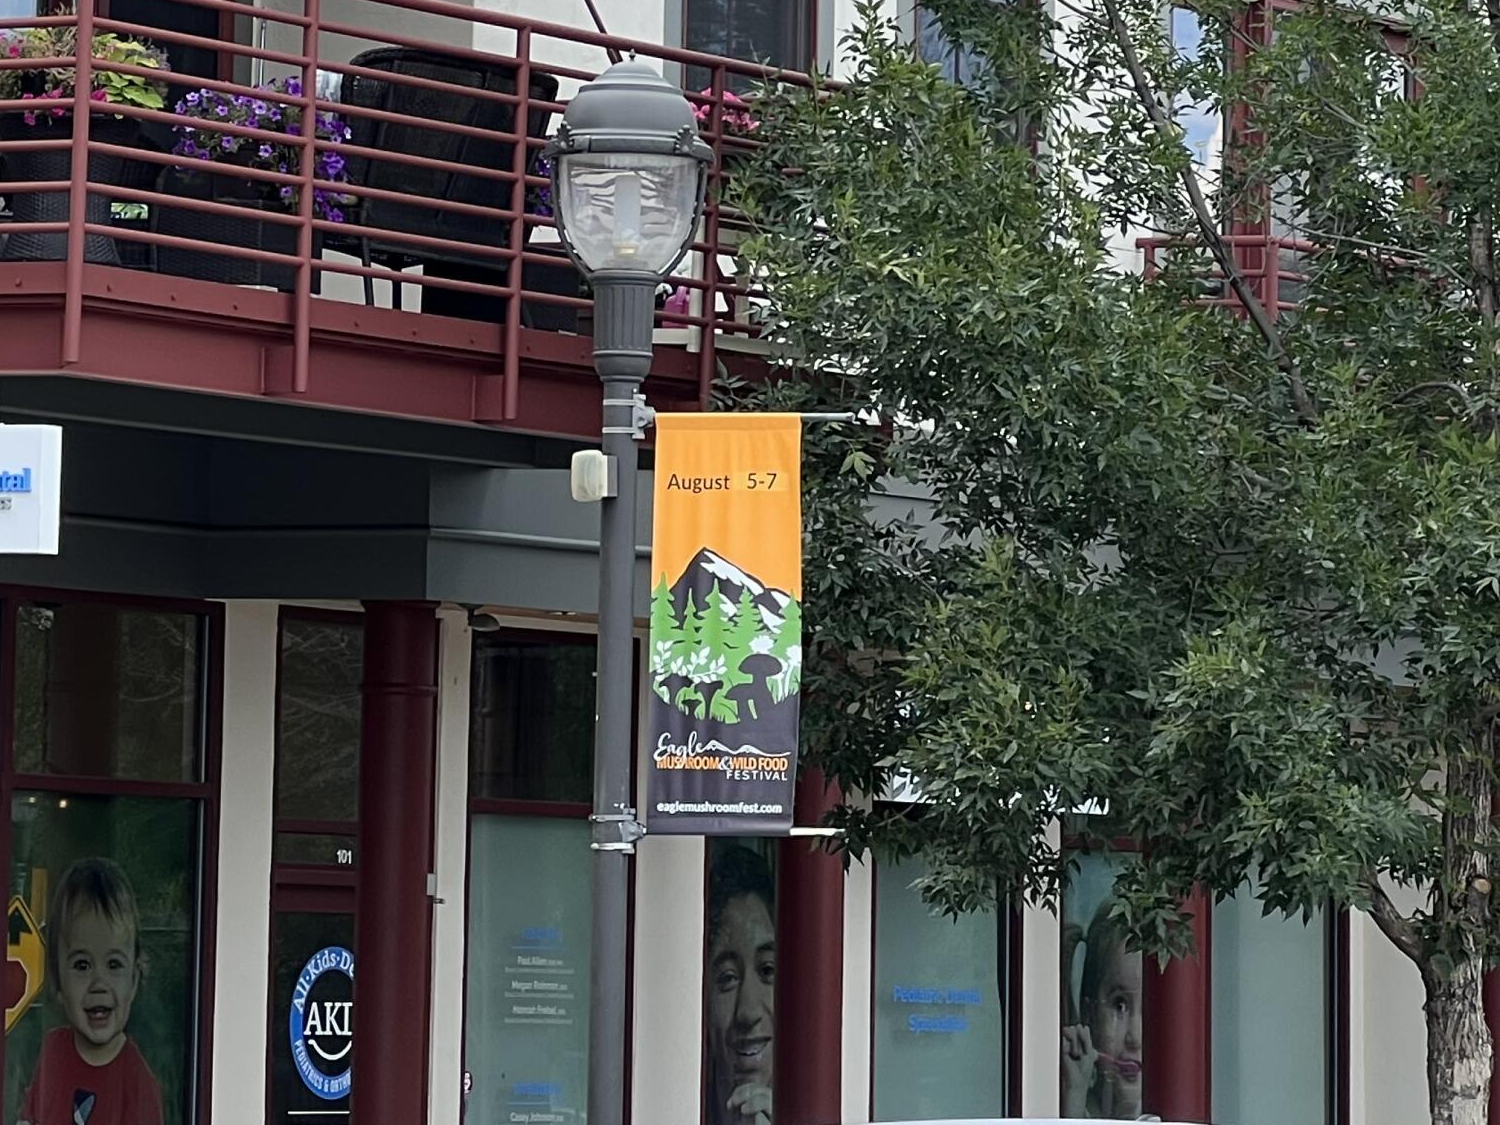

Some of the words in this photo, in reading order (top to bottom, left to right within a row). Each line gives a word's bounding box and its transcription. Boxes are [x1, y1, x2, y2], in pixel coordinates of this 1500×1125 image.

[667, 473, 730, 493] August
[747, 472, 777, 489] 5-7
[653, 731, 704, 763] Eagle
[731, 756, 757, 770] WILD
[758, 757, 789, 771] FOOD
[726, 771, 788, 781] FESTIVAL
[656, 801, 783, 814] eaglemushroomfest.com
[337, 849, 352, 865] 101
